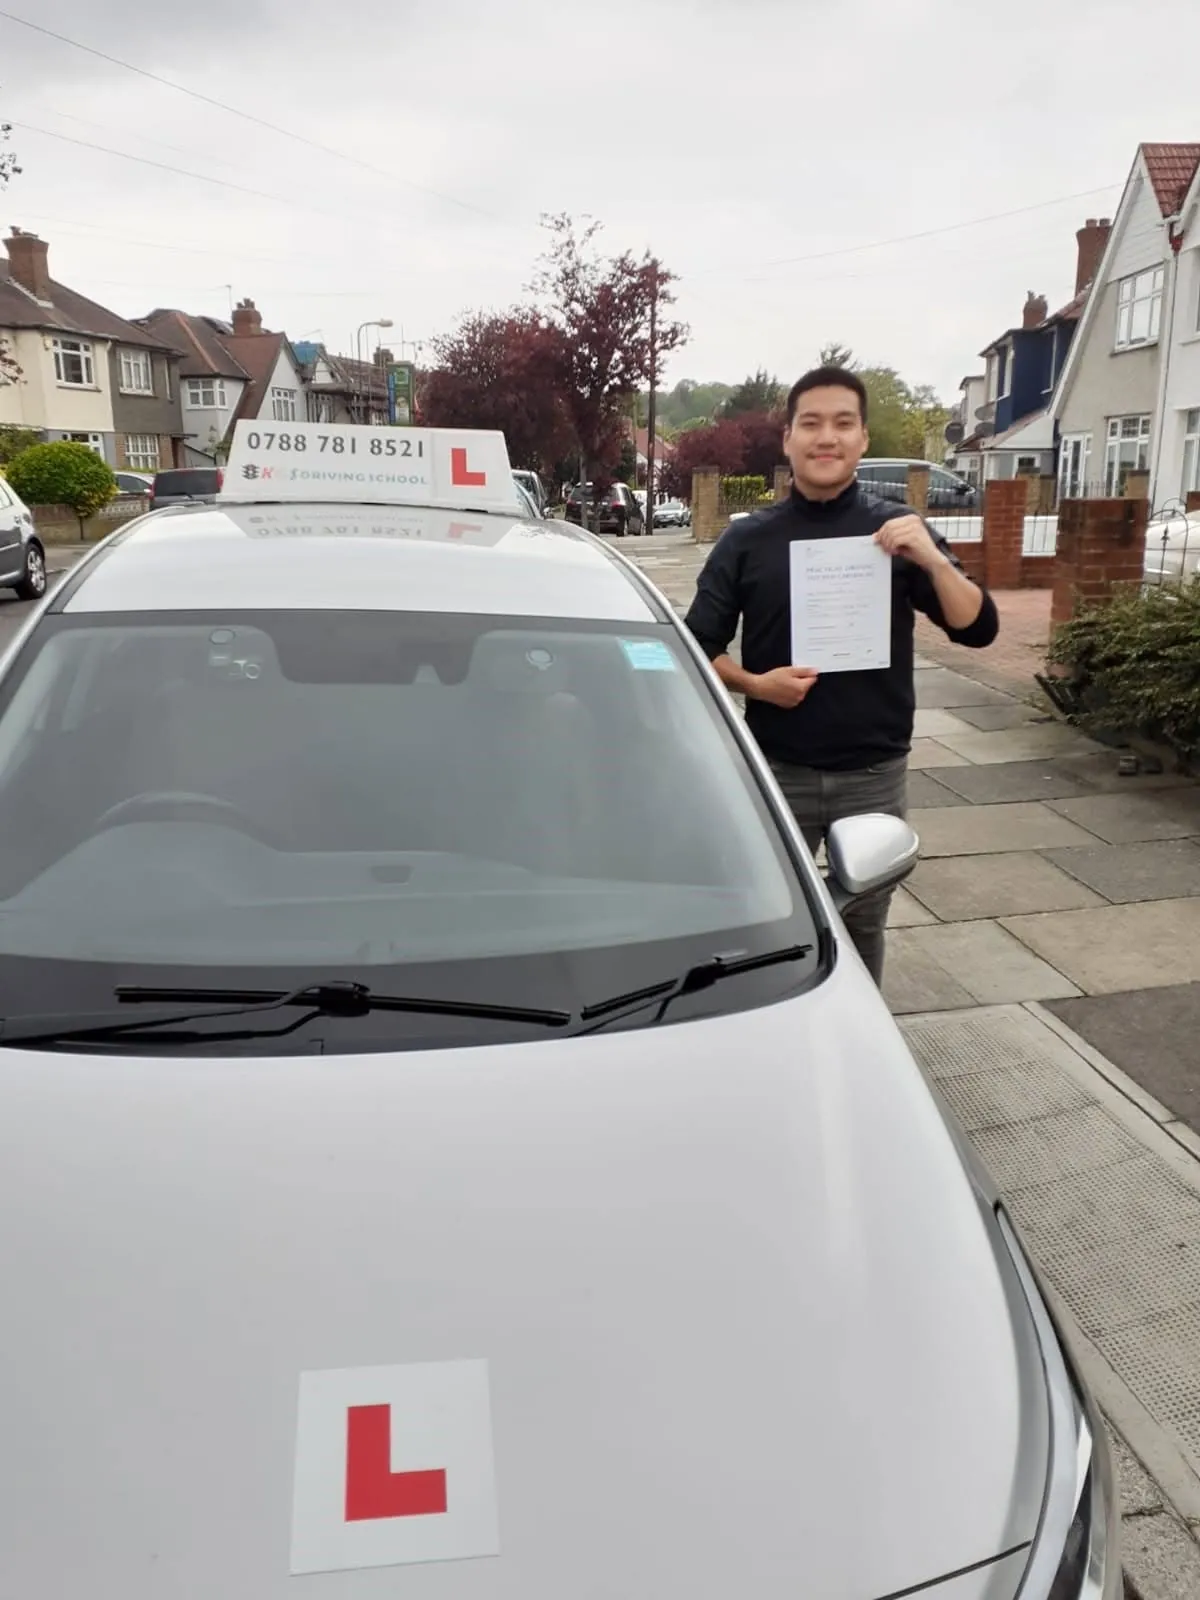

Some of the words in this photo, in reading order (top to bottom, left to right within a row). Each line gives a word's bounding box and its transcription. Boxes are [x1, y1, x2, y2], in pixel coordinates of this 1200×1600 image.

[247, 432, 307, 452] 0788
[317, 435, 357, 455] 781
[369, 438, 424, 458] 8521
[300, 470, 366, 483] DRIVING
[369, 472, 428, 485] SCHOOL
[451, 447, 486, 486] L
[344, 1403, 448, 1522] L
